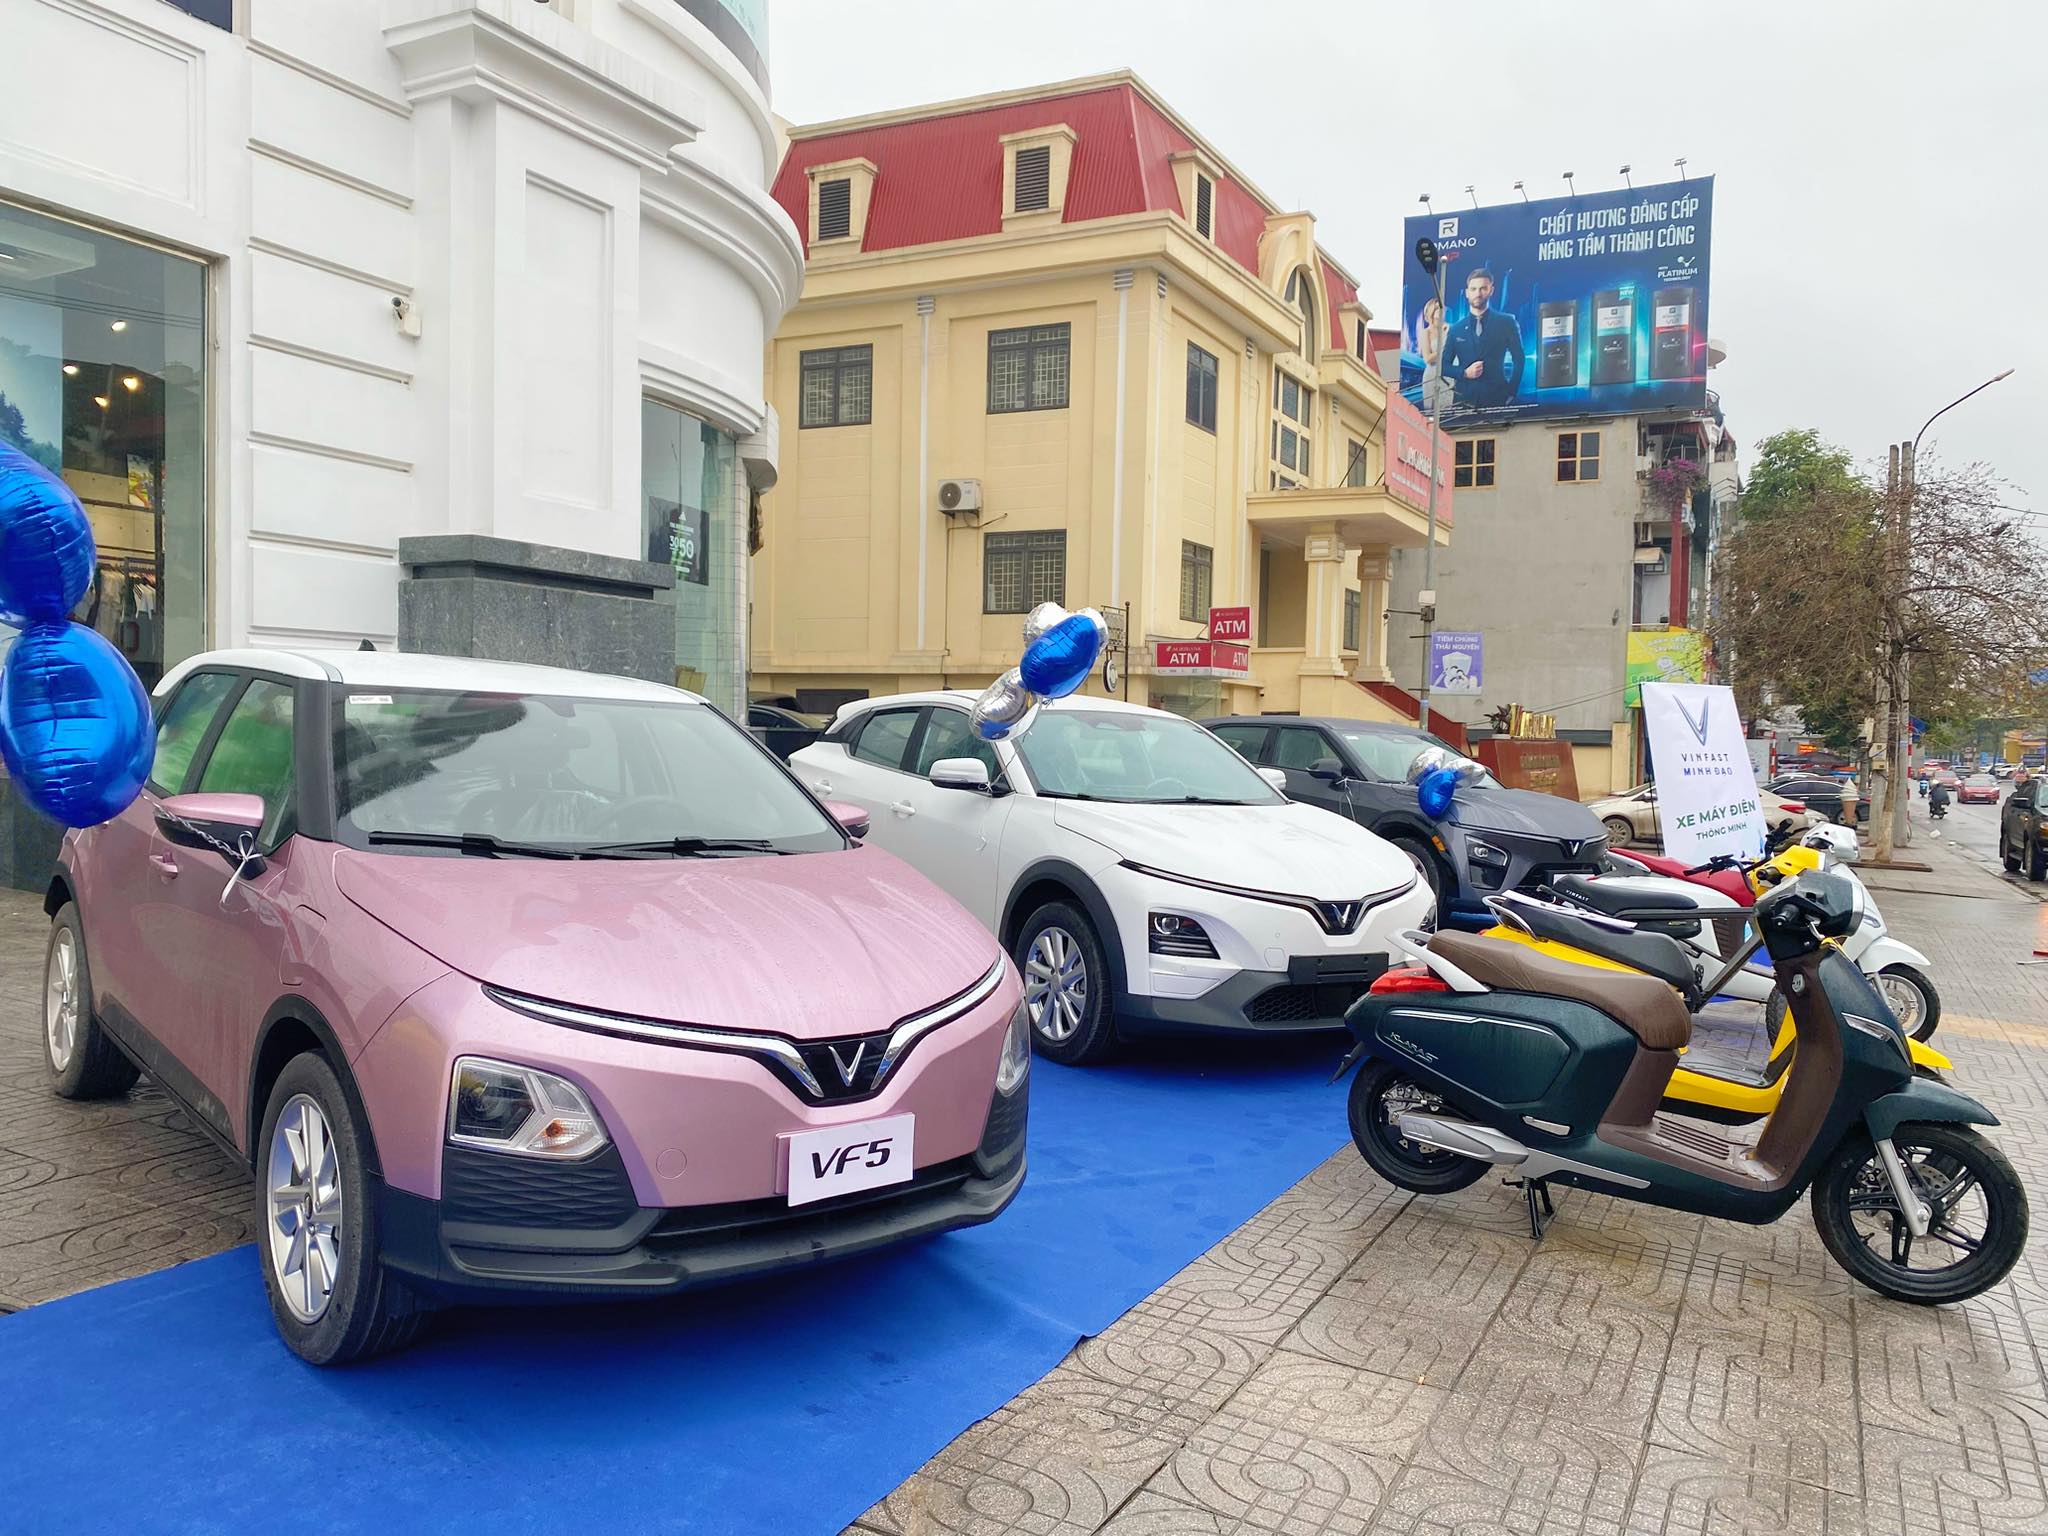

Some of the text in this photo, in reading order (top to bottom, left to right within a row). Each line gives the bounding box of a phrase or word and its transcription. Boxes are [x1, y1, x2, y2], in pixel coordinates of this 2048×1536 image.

[1538, 192, 1699, 236] CHẤT HƯƠNG ĐẲNG CẤP
[1538, 224, 1695, 261] NÂNG TẦM THÀNH CÔNG
[1657, 267, 1698, 279] PLATINUM
[1213, 619, 1246, 635] ATM
[1169, 652, 1200, 665] ATM
[1232, 650, 1248, 667] ATM
[1681, 753, 1728, 762] VINFAST
[1683, 766, 1712, 776] MINH
[1676, 799, 1757, 830] XE MÁY ĐIỆN
[1696, 821, 1748, 841] THÔNG MINH
[1565, 888, 1590, 902] VINFAST
[811, 1137, 894, 1180] VF5
